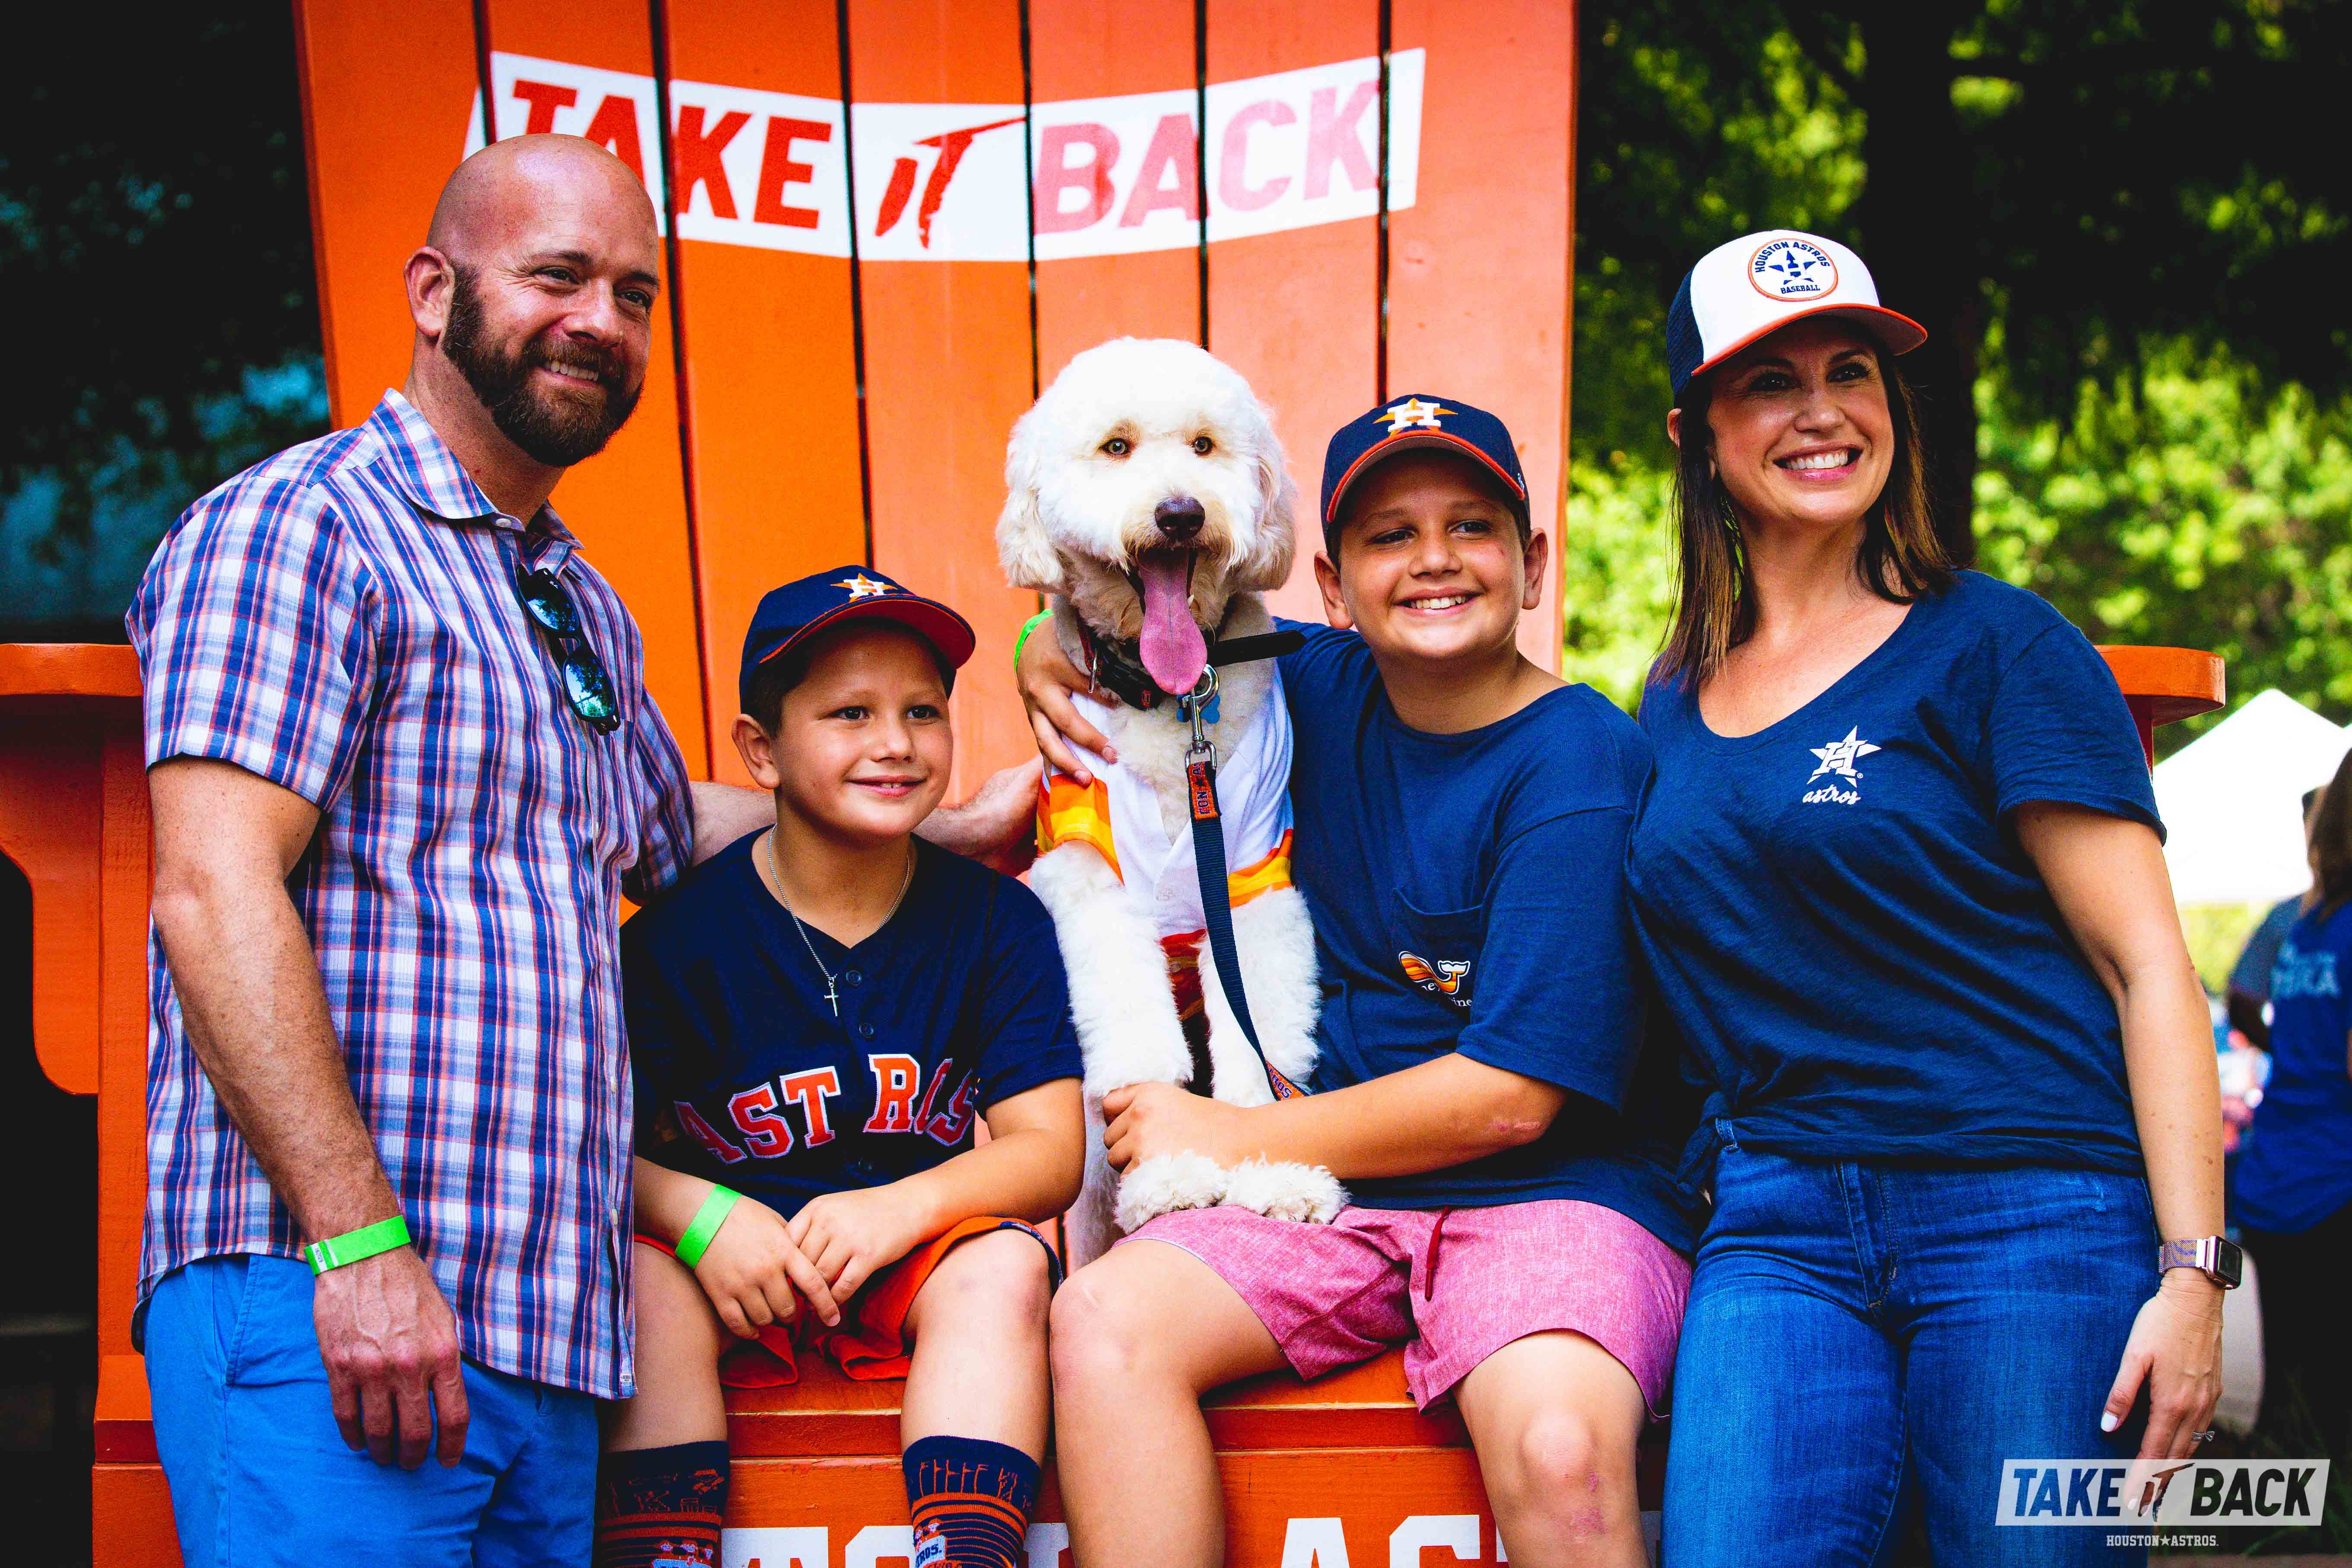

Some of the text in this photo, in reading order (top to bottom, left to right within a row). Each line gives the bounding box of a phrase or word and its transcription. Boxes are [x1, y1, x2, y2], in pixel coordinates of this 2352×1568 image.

[1033, 79, 1380, 235] BACK
[1755, 241, 1830, 272] HOUSTON ASTROS
[1780, 285, 1821, 294] BASEBALL
[1802, 784, 1861, 805] astros
